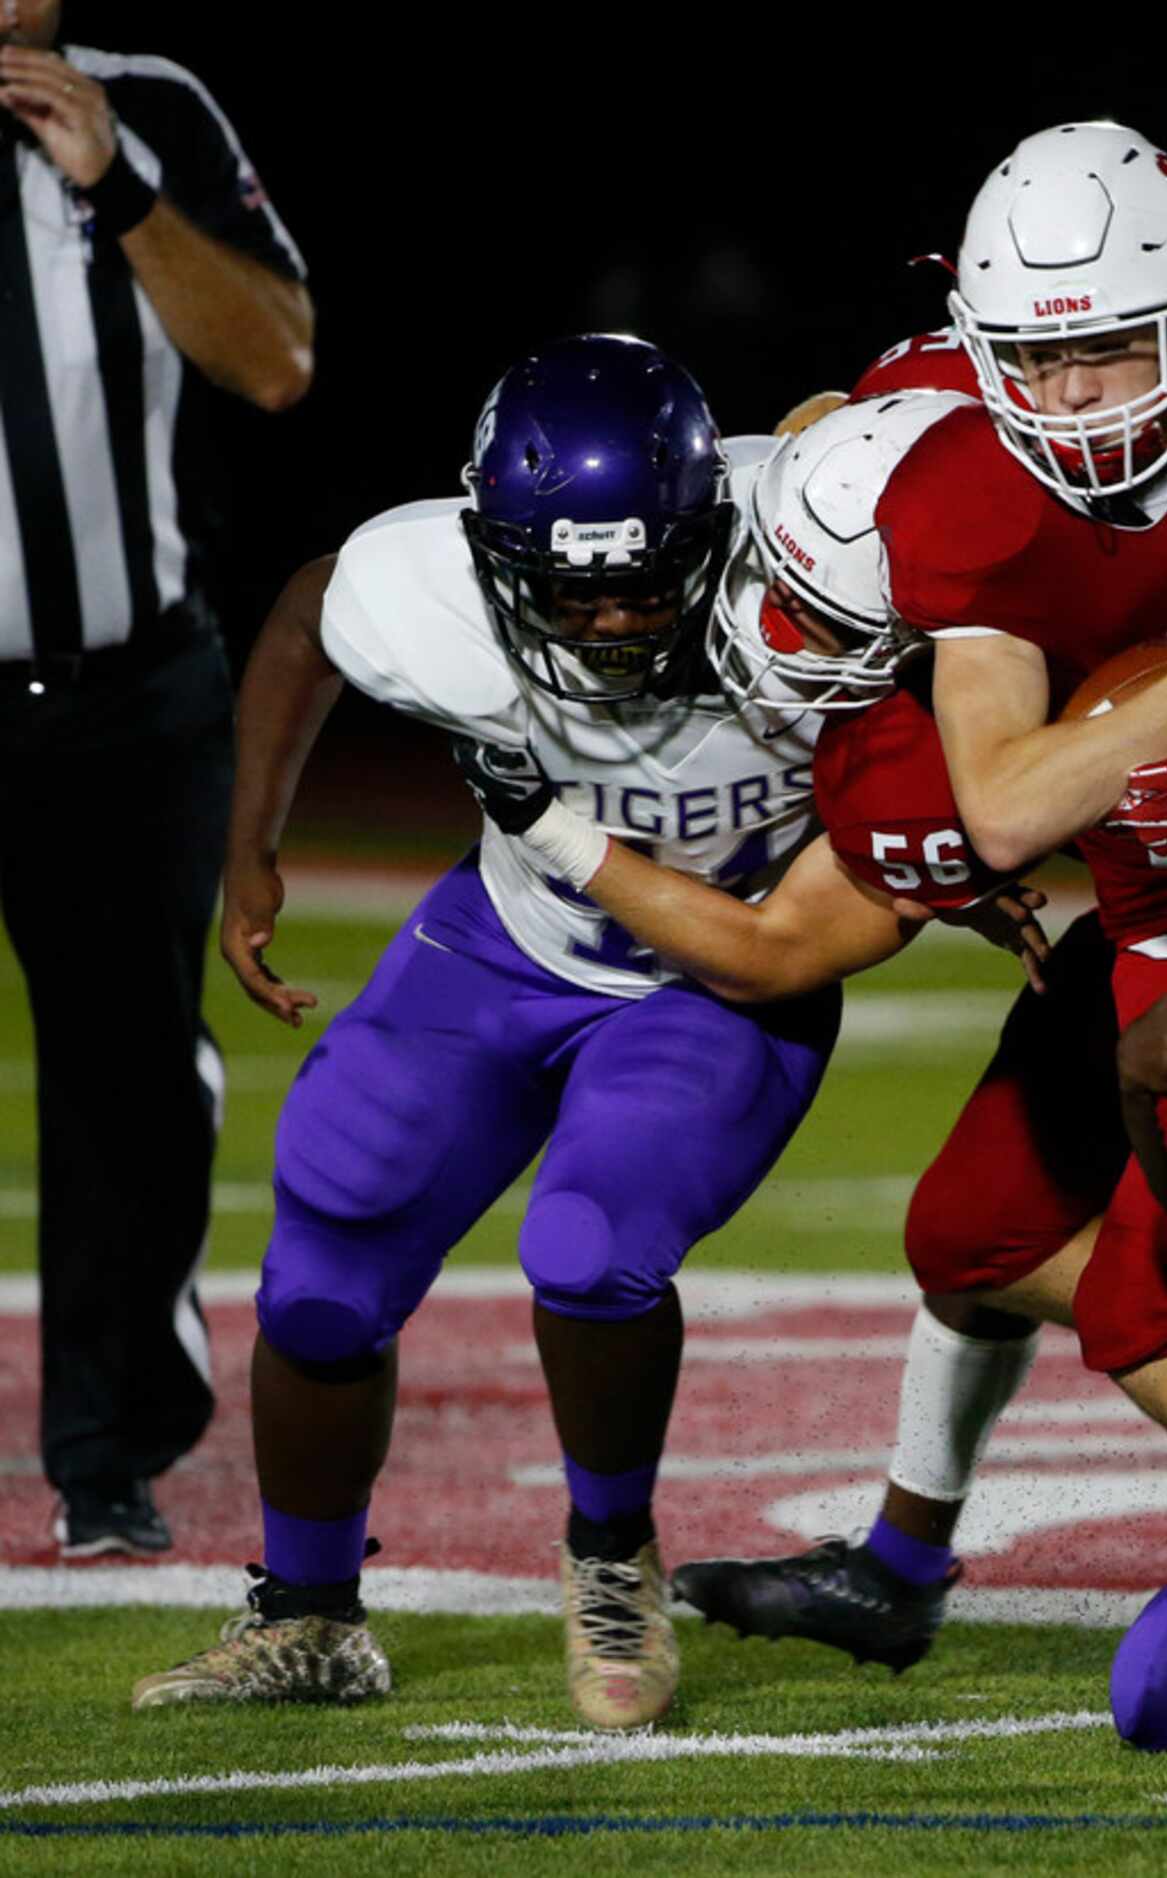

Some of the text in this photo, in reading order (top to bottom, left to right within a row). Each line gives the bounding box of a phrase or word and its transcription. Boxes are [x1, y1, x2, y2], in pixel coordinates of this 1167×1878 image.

[1033, 295, 1092, 317] LIONS
[774, 523, 816, 573] LIONS
[870, 828, 971, 891] 56
